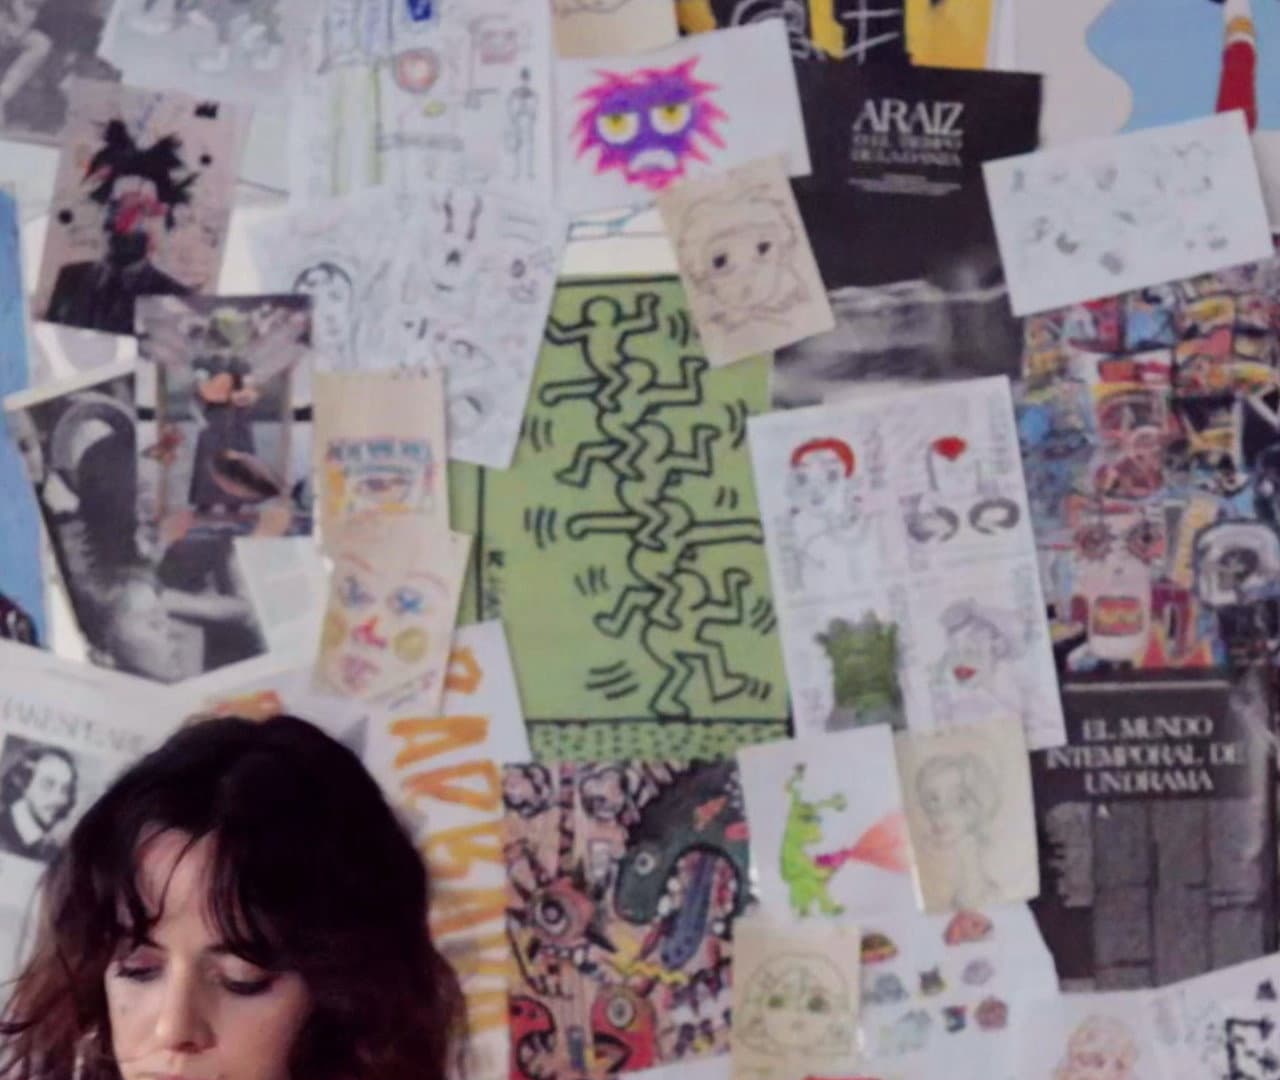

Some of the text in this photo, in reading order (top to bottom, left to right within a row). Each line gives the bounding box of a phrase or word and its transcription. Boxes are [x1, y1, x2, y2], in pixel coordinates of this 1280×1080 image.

[852, 98, 964, 135] ARAIZ
[1082, 715, 1214, 741] EL MUNDO
[1046, 743, 1247, 770] INTEMPORAL DE
